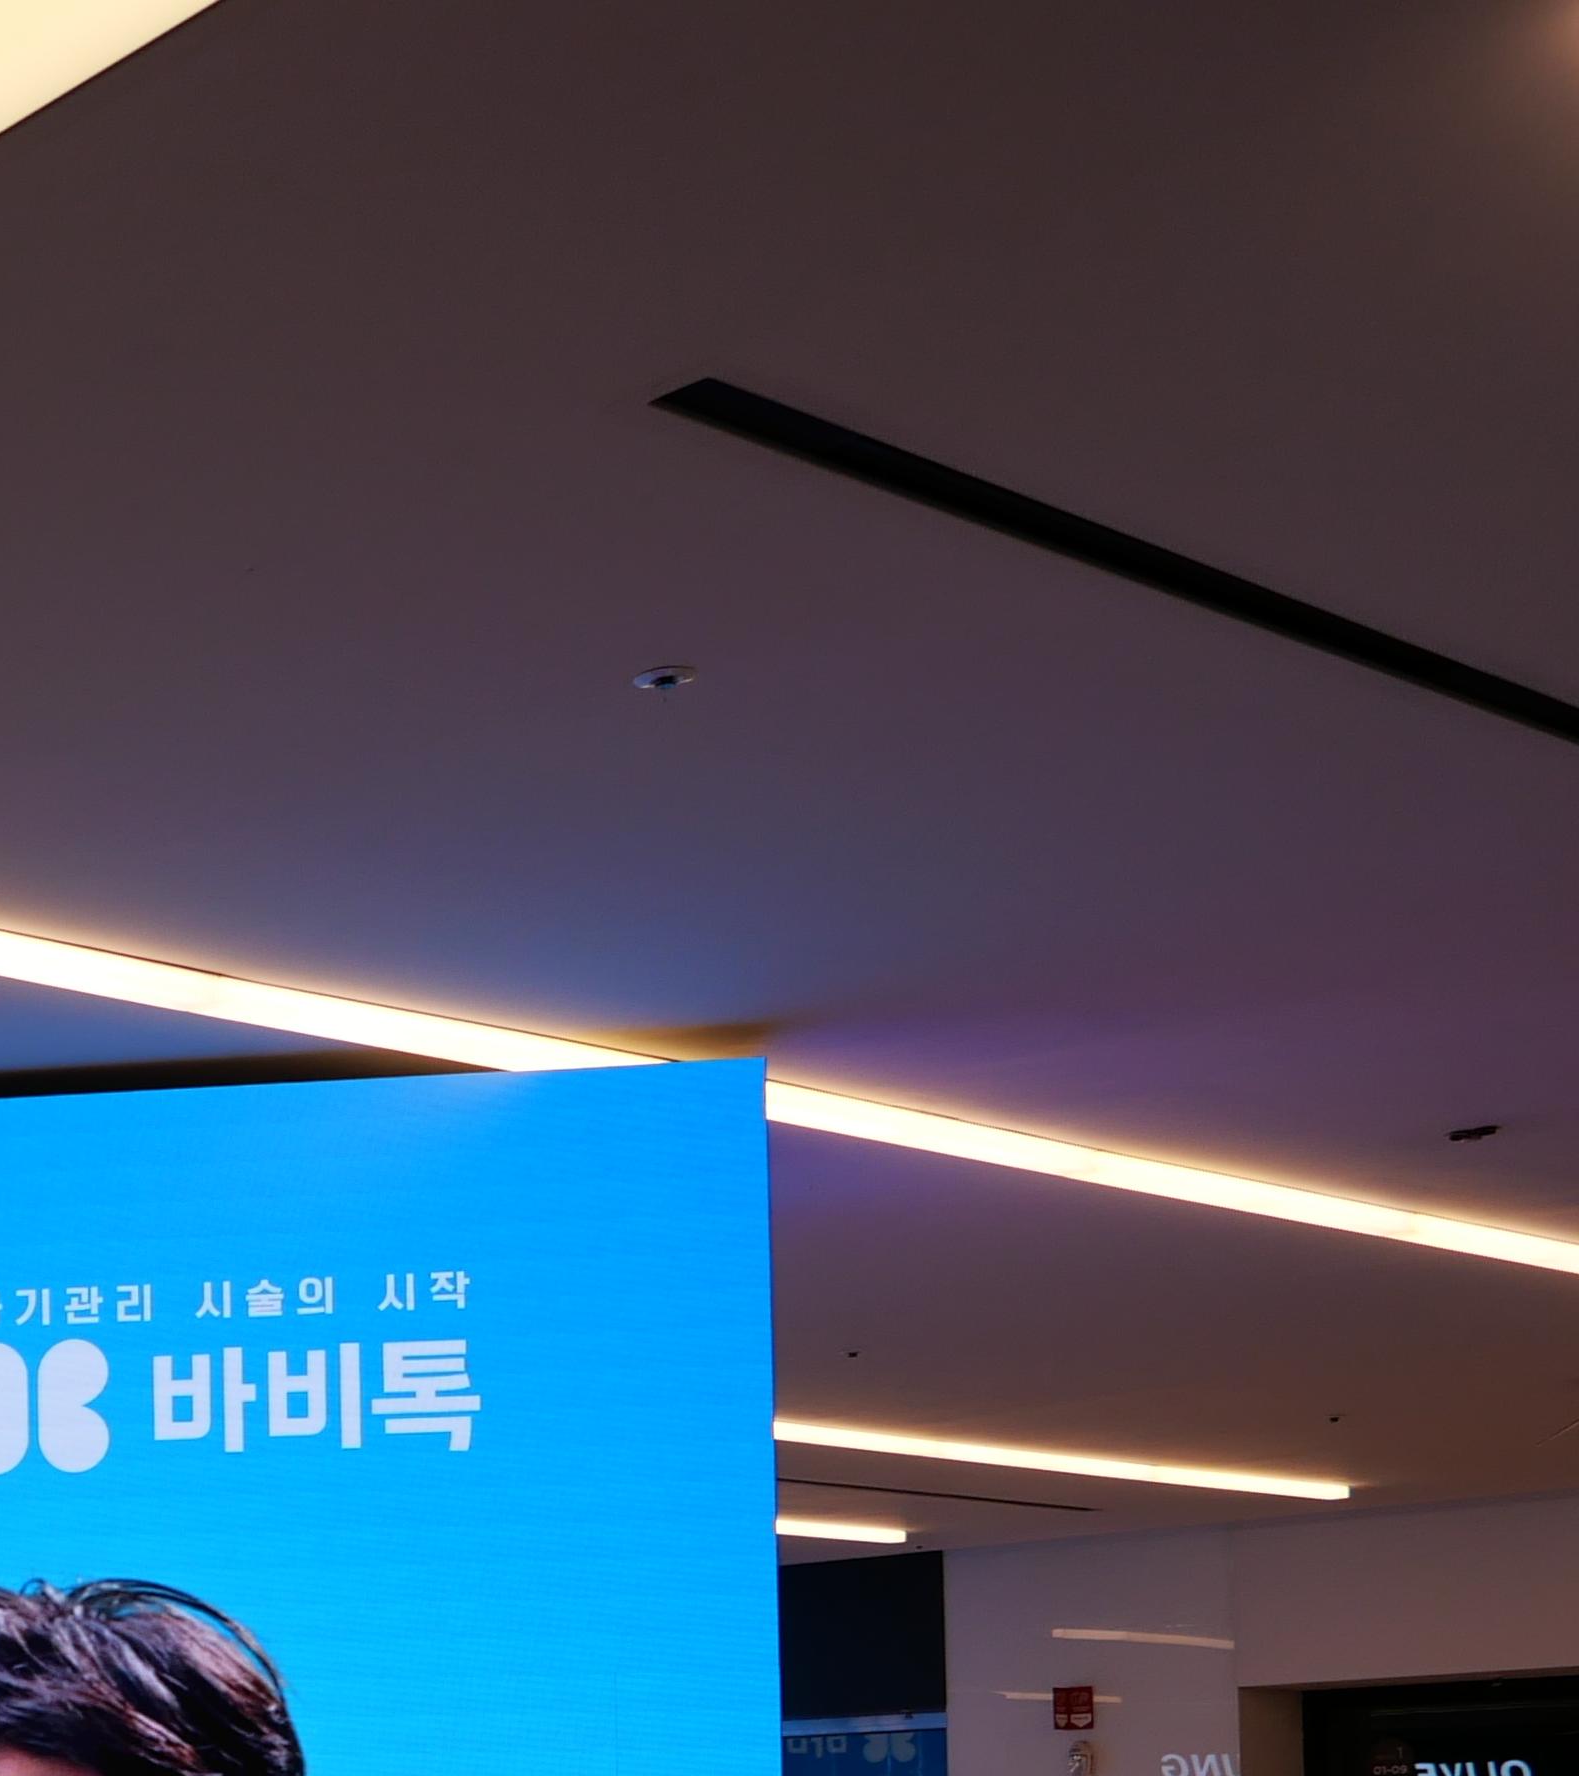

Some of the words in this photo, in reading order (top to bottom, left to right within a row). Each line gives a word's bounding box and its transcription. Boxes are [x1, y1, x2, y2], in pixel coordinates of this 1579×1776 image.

[194, 1276, 336, 1319] 시술의
[378, 1270, 471, 1312] 시작
[151, 1338, 482, 1454] 바비톡
